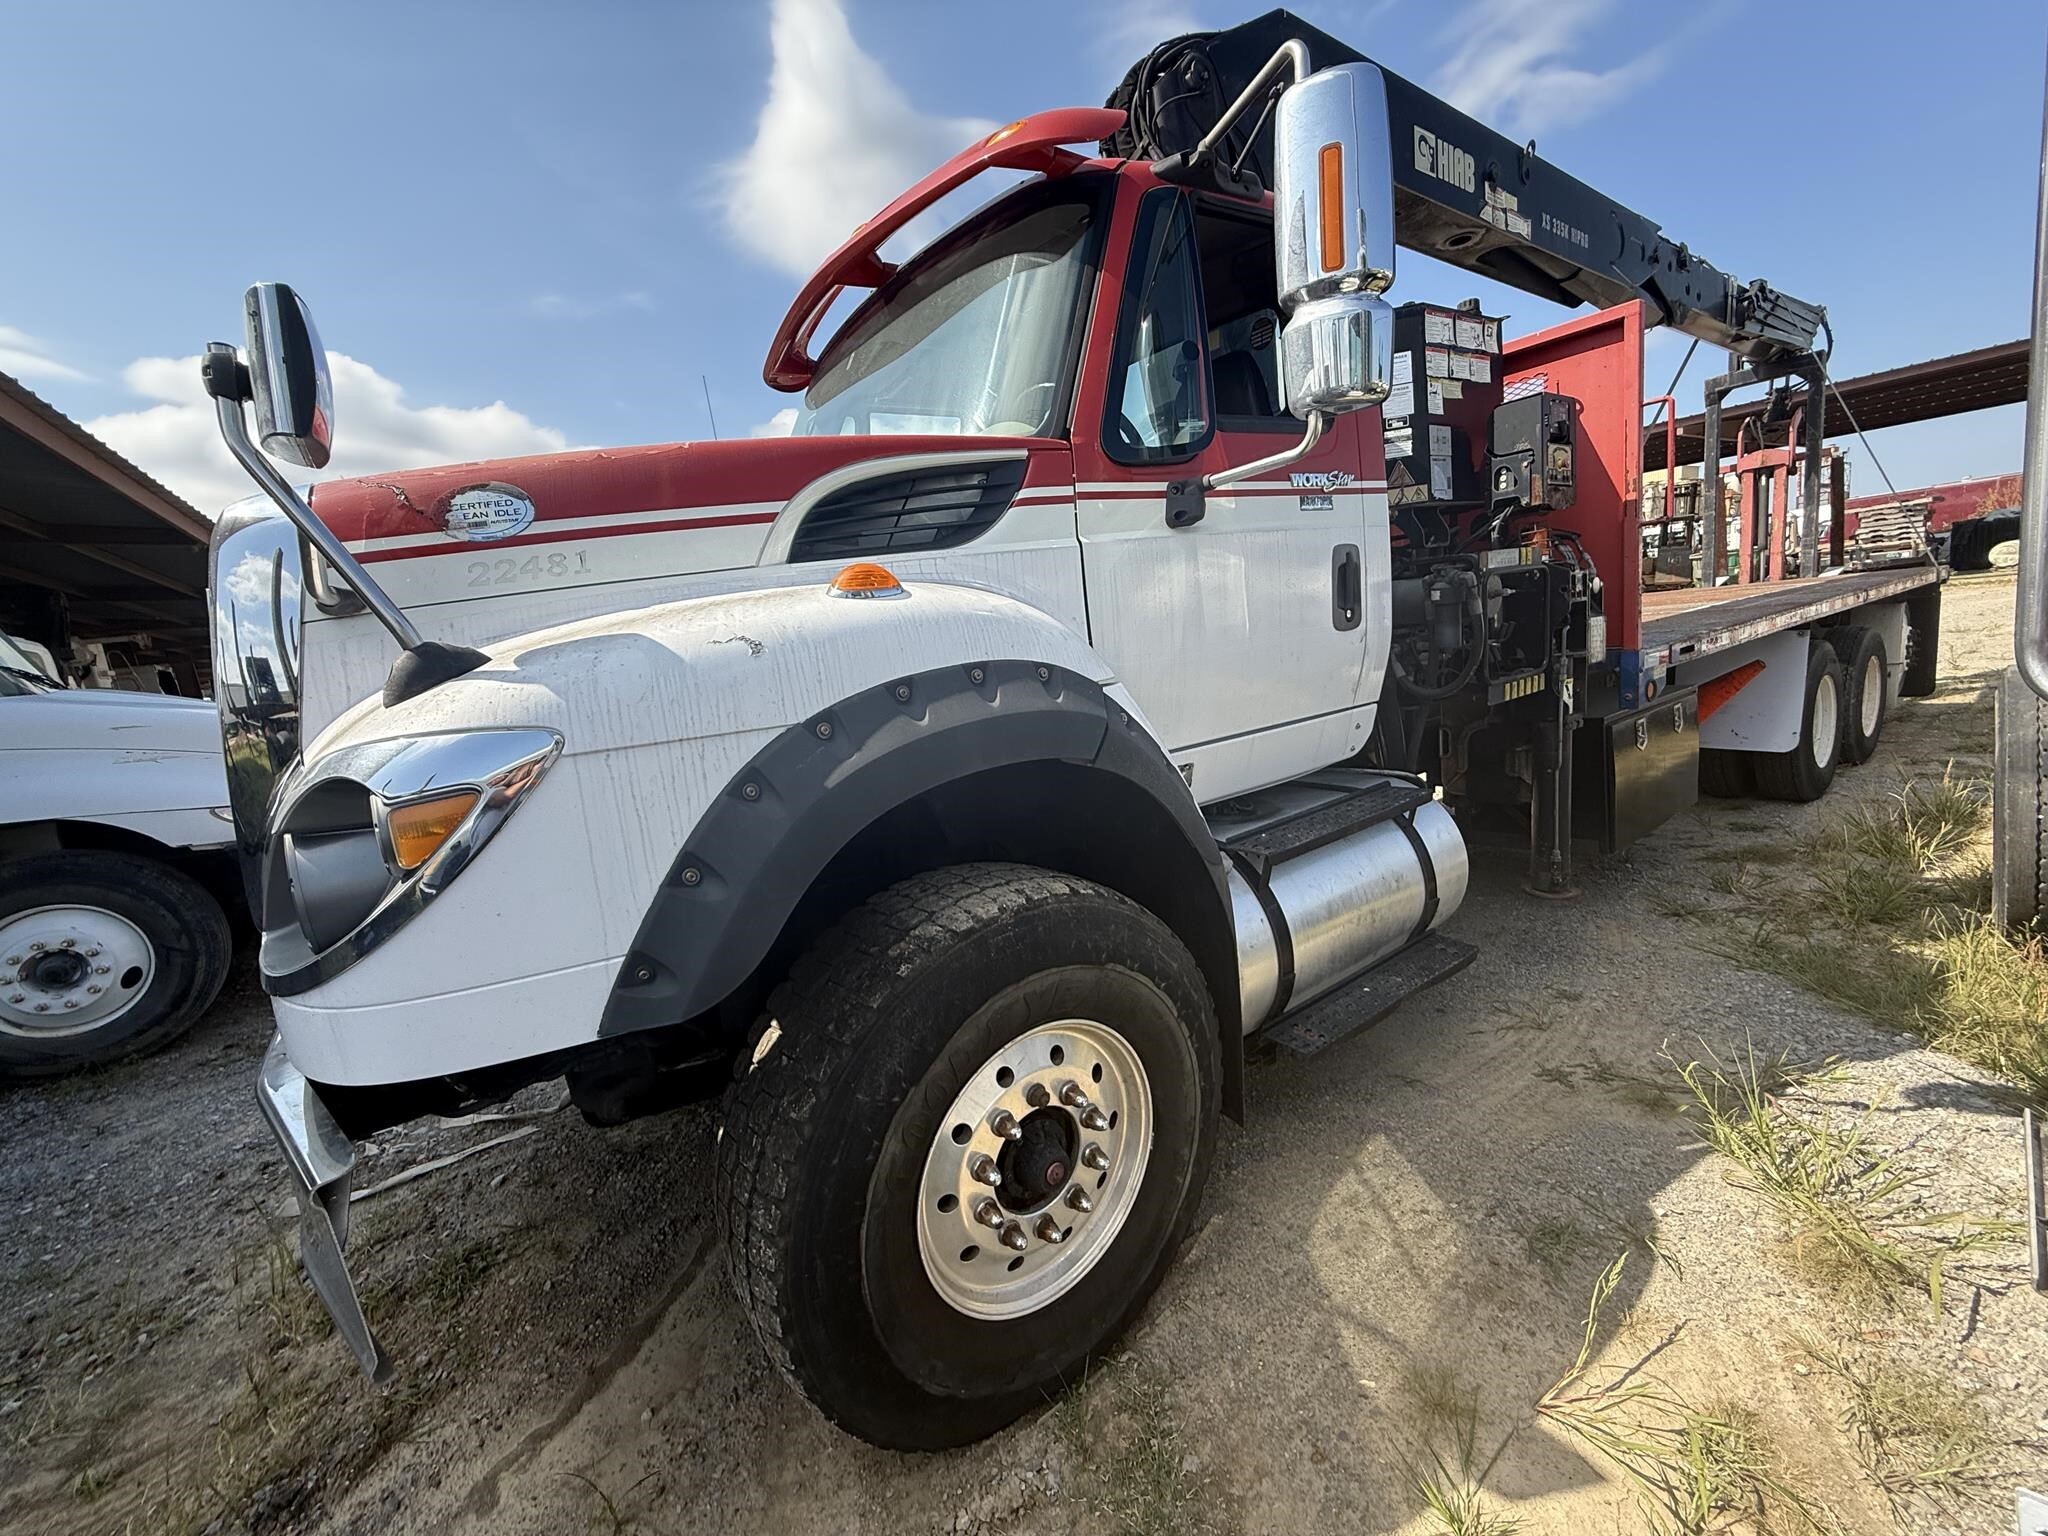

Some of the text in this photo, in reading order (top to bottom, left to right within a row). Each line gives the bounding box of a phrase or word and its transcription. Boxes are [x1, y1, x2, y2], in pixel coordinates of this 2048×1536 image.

[1437, 138, 1476, 194] HIAB
[1541, 211, 1551, 231] XS
[451, 498, 514, 512] CERTIFIED
[463, 507, 522, 521] EAN IDLE
[467, 549, 592, 589] 22481
